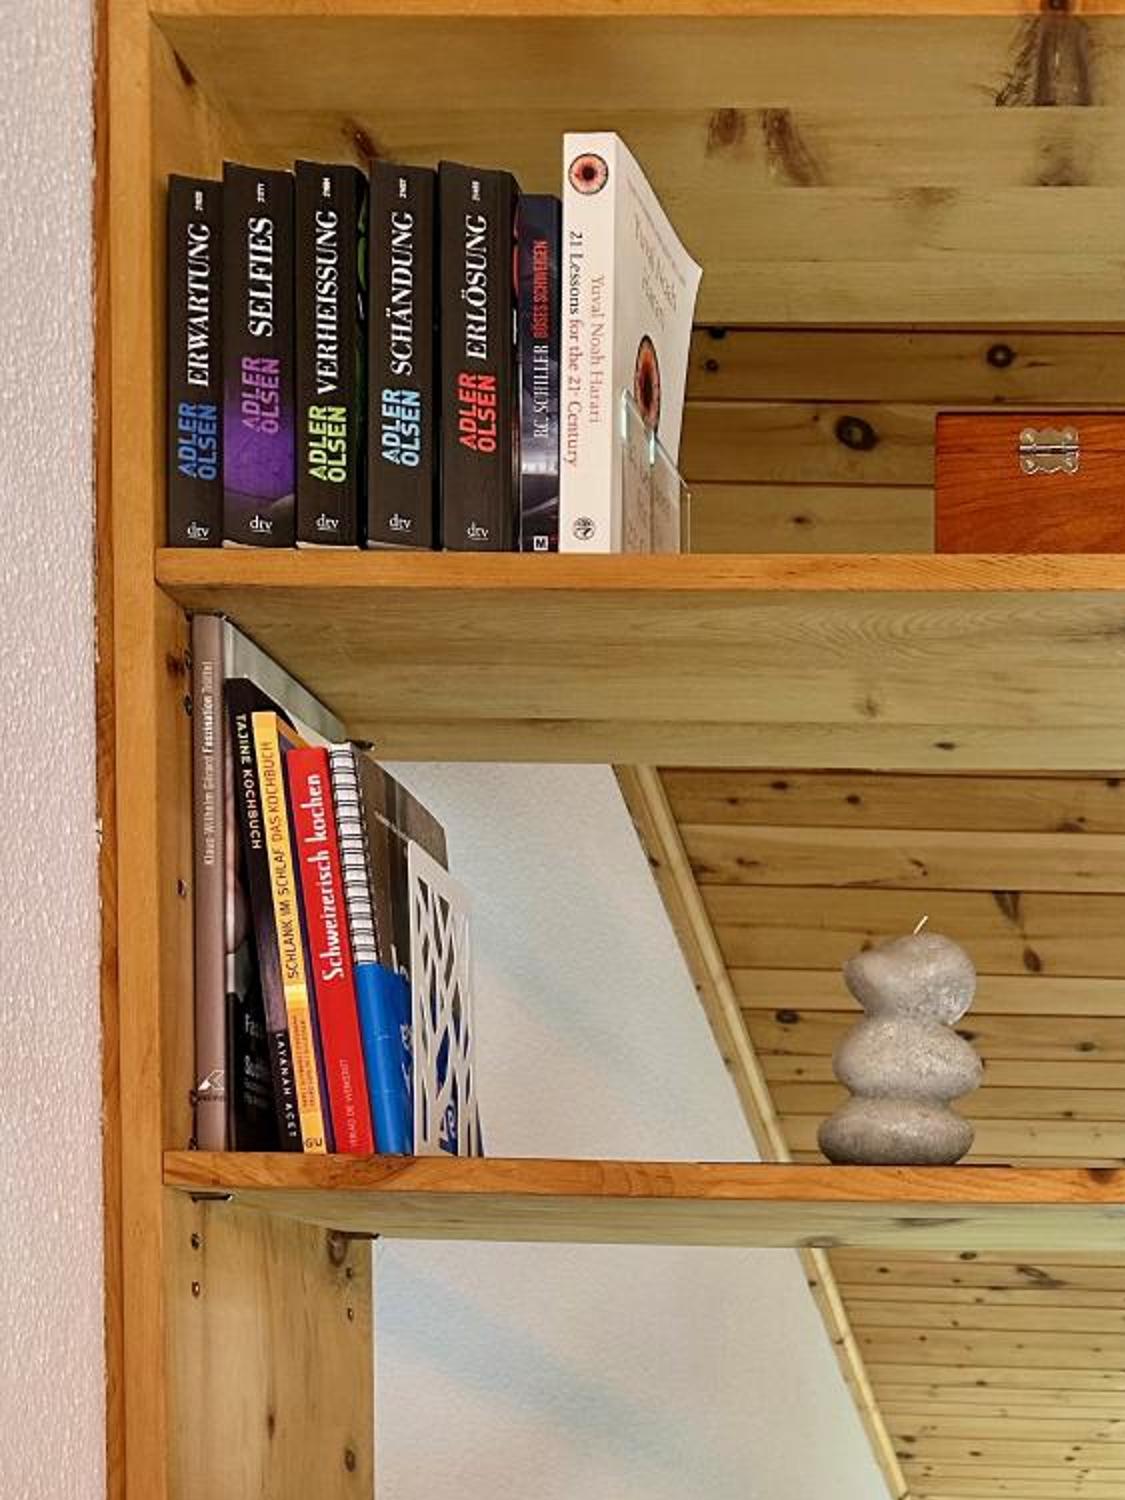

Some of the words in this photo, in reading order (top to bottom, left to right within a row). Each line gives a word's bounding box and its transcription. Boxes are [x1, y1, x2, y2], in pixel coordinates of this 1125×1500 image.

[248, 216, 274, 337] SELFIES
[569, 230, 583, 247] 21
[187, 223, 212, 387] ERWARTUNG
[315, 210, 340, 395] VERHEISSUNG
[385, 211, 414, 377] SCHÄNDUNG
[460, 214, 488, 360] ERLÖSUNG
[569, 252, 584, 315] Lessons
[591, 275, 606, 318] Yuval
[568, 319, 583, 341] for
[568, 345, 583, 371] the
[590, 323, 606, 365] Noah
[241, 356, 261, 432] ADLER
[261, 358, 280, 434] OLSEN
[458, 372, 478, 451] ADLER
[477, 374, 497, 453] OLSEN
[533, 345, 549, 413] SCHILLER
[588, 370, 605, 424] Harari
[178, 402, 197, 479] ADLER
[197, 404, 217, 480] OLSEN
[308, 405, 327, 481] ADLER
[327, 405, 347, 483] OLSEN
[381, 388, 401, 465] ADLER
[400, 390, 421, 467] OLSEN
[563, 400, 582, 467] Century
[202, 694, 214, 753] Faszination
[236, 714, 251, 766] TAJINE
[243, 769, 263, 850] KOCHBUCH
[261, 741, 279, 817] KOCHBUCH
[299, 773, 328, 844] kochen
[268, 815, 283, 842] DAS
[273, 848, 289, 896] SCHLAF
[279, 901, 291, 917] IM
[282, 918, 299, 979] SCHLANK
[307, 850, 345, 981] Schweizerisch
[276, 1032, 292, 1096] LAYANAH
